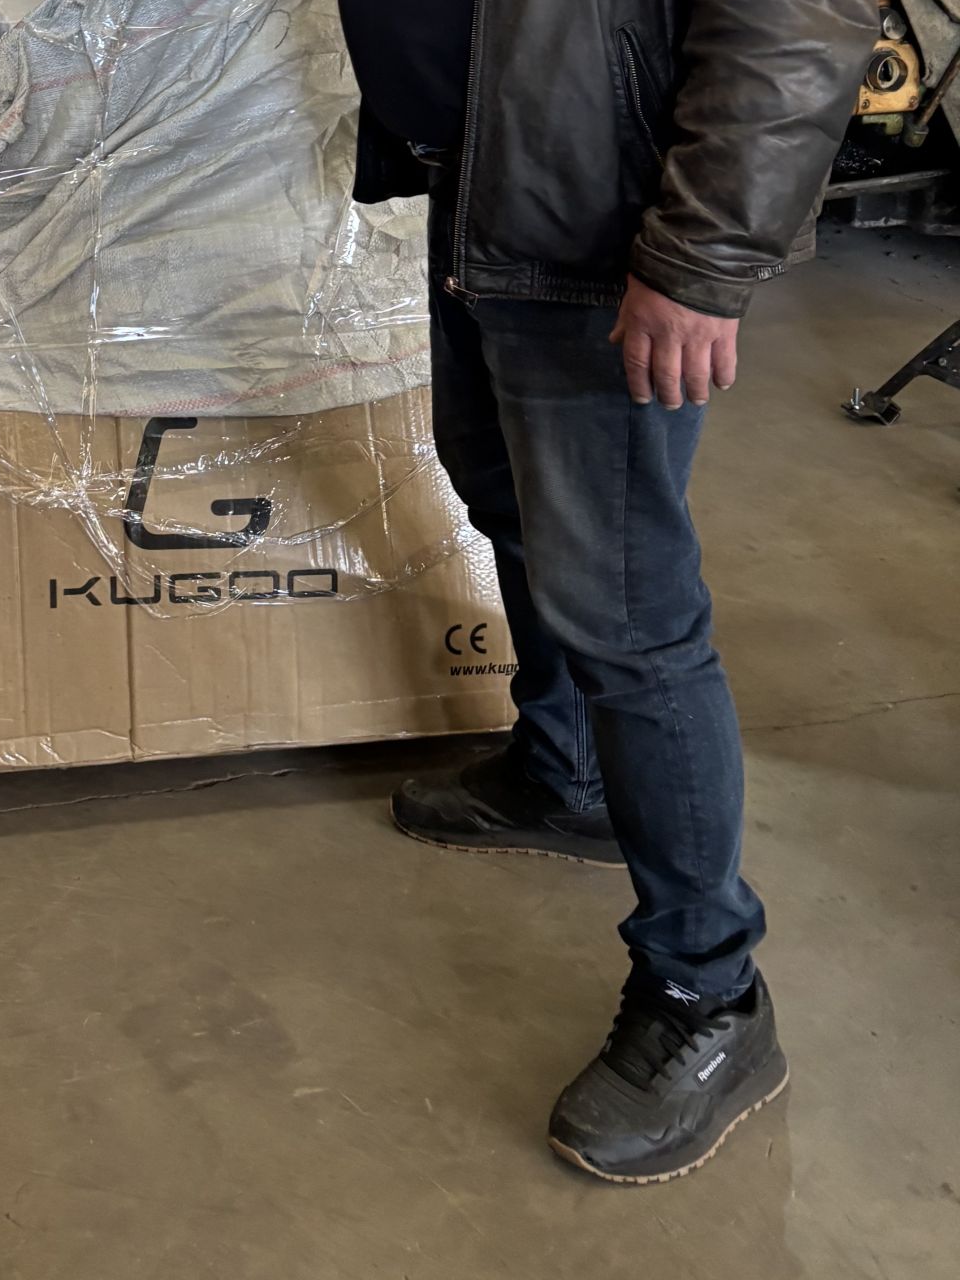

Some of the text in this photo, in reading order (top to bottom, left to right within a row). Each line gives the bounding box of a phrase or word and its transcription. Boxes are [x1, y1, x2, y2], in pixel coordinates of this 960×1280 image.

[124, 417, 272, 550] G
[49, 568, 339, 609] KUGOO
[445, 623, 487, 655] CE
[697, 1051, 727, 1082] Reebok
